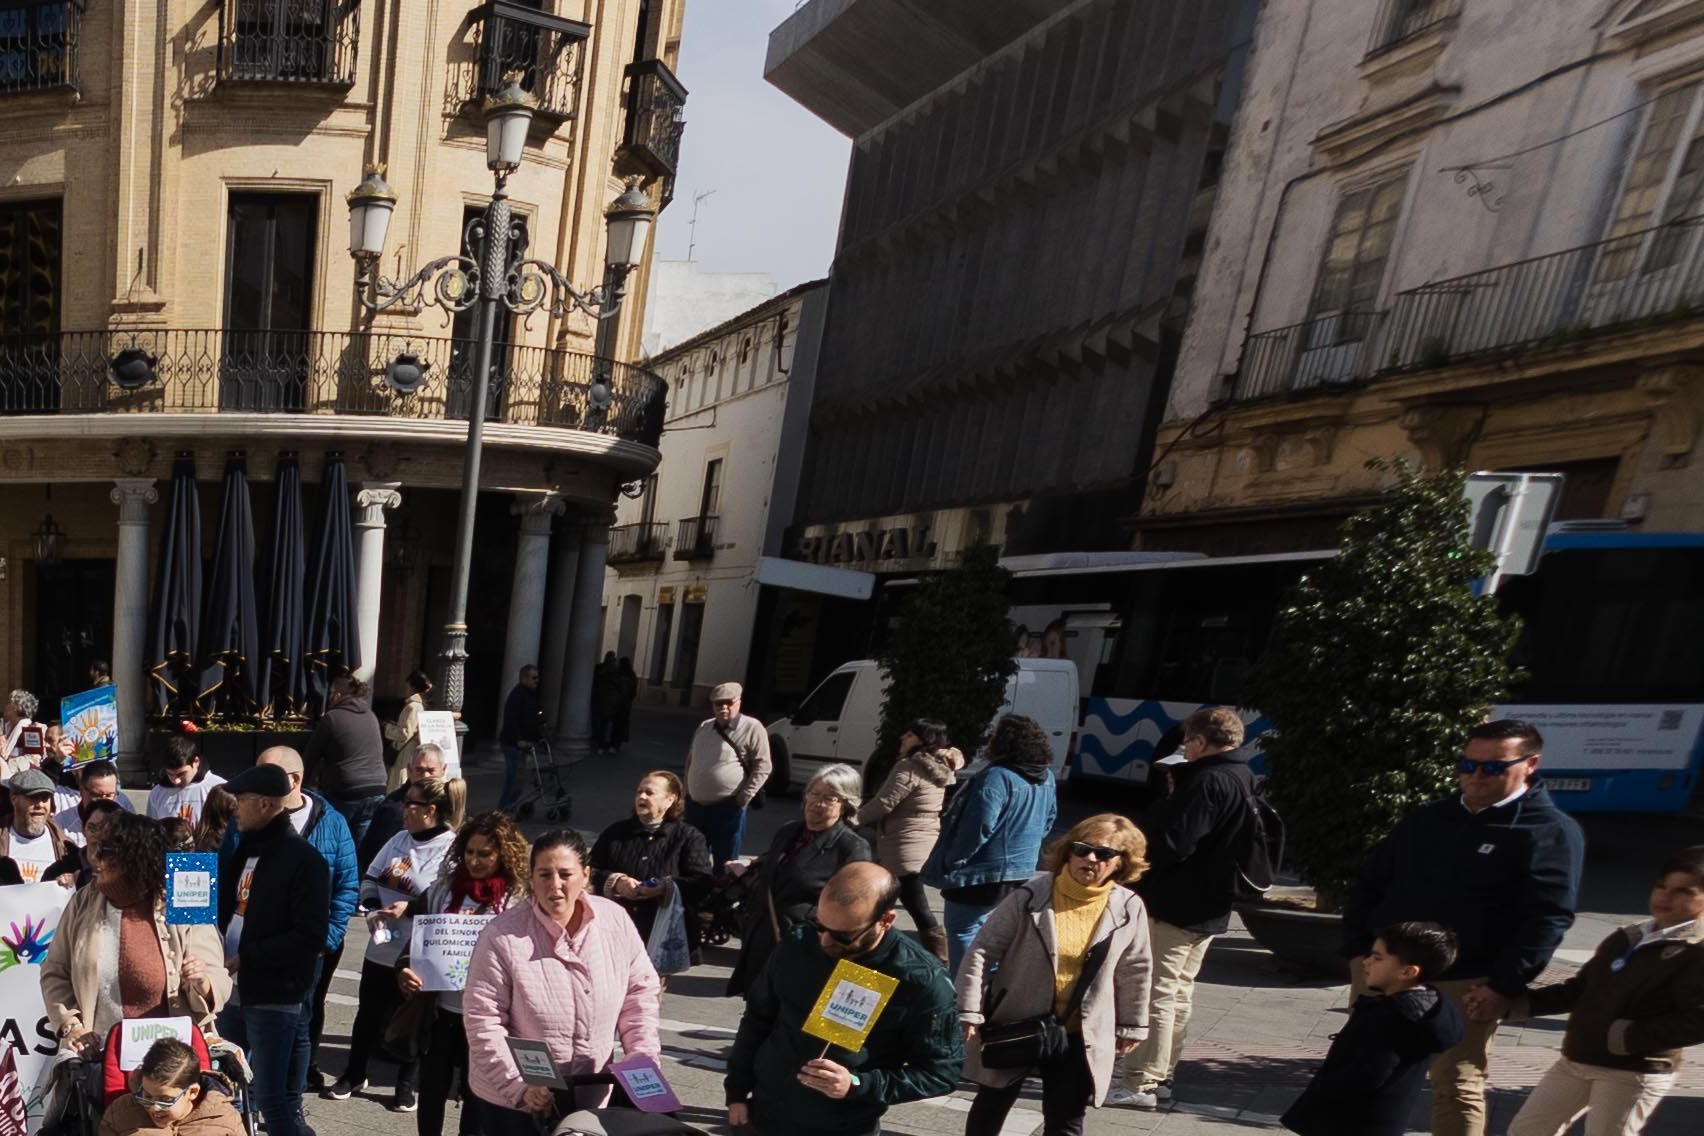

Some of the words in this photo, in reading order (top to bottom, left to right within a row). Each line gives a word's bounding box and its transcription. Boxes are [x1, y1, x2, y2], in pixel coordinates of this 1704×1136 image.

[417, 917, 447, 926] SOMOS
[449, 917, 460, 925] LA
[434, 928, 449, 936] DEL
[830, 1002, 868, 1021] UNIPER
